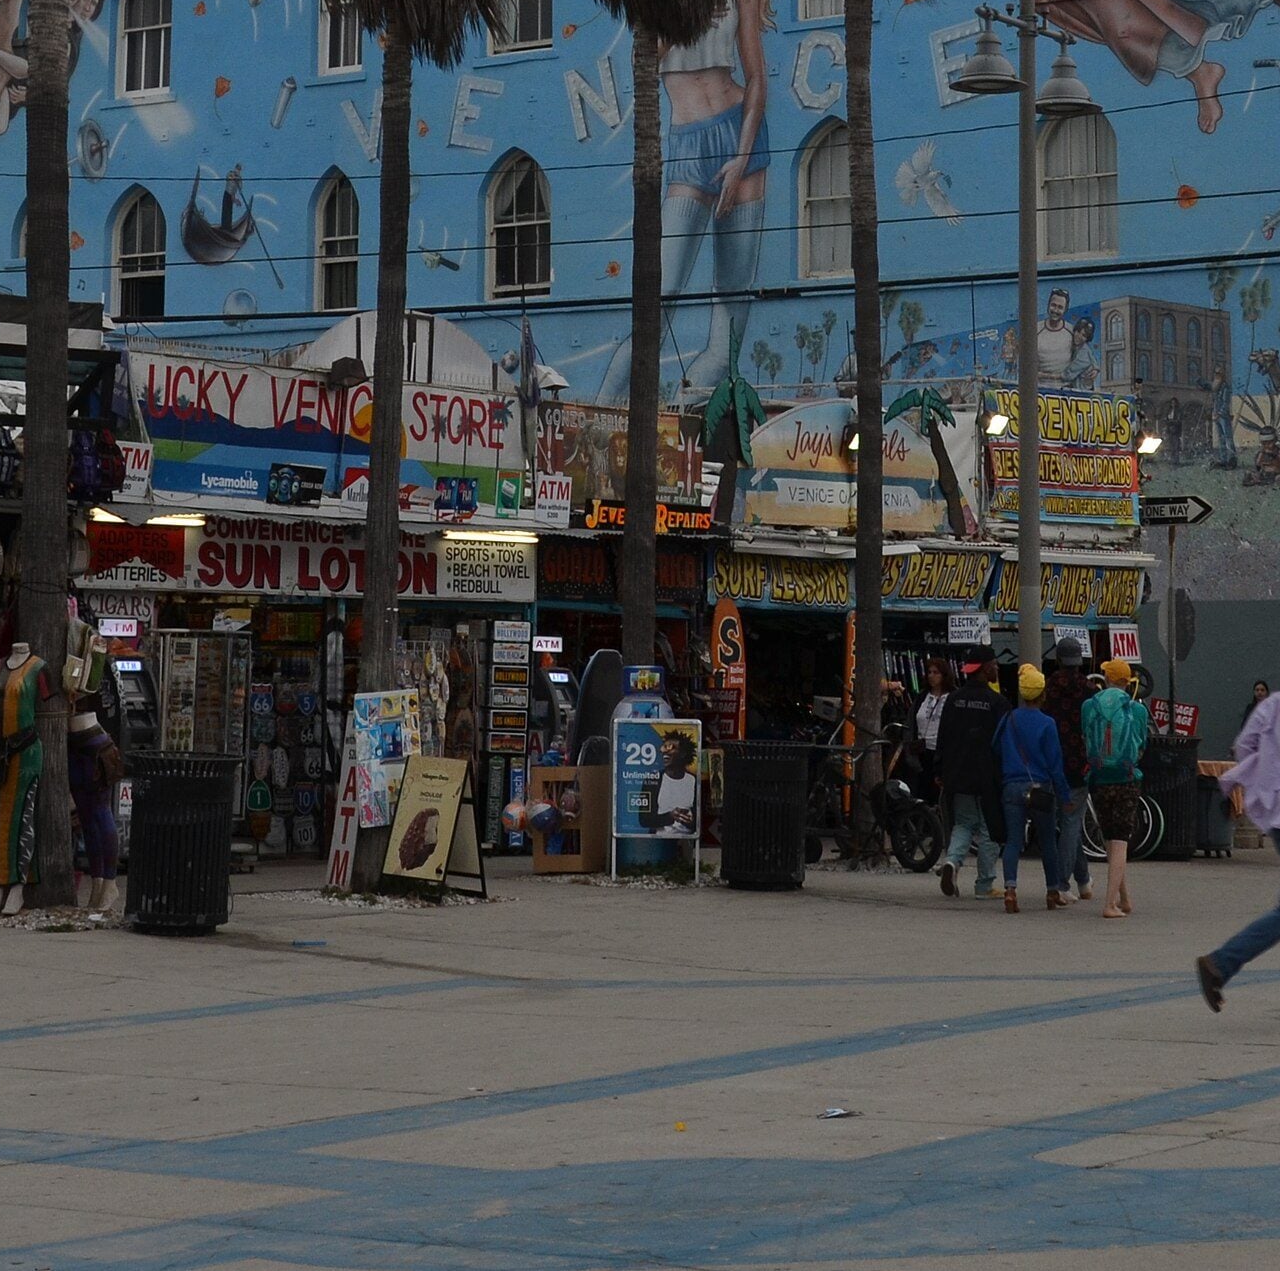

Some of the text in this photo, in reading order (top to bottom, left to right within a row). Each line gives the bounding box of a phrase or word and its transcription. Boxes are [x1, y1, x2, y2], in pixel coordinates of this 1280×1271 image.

[147, 365, 504, 450] UCKY VENIC STORE
[1037, 394, 1131, 445] RENTALS
[787, 421, 833, 468] Jay's
[122, 447, 150, 471] TM
[1071, 455, 1095, 485] SURF
[1096, 456, 1132, 486] BOARDS
[201, 472, 259, 490] Lycamobile
[538, 480, 570, 500] ATM
[788, 486, 835, 504] VENICE
[655, 503, 711, 533] REPAIRS
[1145, 504, 1190, 517] ONE WAY
[202, 516, 344, 544] CONVENIENCE
[98, 531, 168, 547] ADAPTERS
[446, 548, 524, 563] SPORTS TOYS
[96, 566, 167, 582] BATTERIES
[198, 541, 438, 595] SUN LOTON
[453, 563, 530, 579] BEACH TOWEL
[899, 551, 990, 599] RENTALS
[453, 579, 502, 594] REDBULL
[714, 550, 768, 597] SURF
[771, 555, 850, 606] LESSONS
[1055, 564, 1095, 616] BIKES
[1097, 567, 1140, 617] SKATES
[88, 593, 152, 617] CIGARS
[950, 617, 979, 627] ELECTRIC
[950, 630, 973, 639] SCOOTER
[1056, 628, 1087, 640] LUGGAGE
[536, 639, 560, 649] ATM
[1113, 633, 1138, 657] ATM
[253, 700, 270, 712] 66
[303, 696, 311, 710] 5
[1153, 710, 1193, 727] STOAGE
[300, 727, 314, 744] 66
[308, 762, 321, 776] 66
[622, 770, 660, 780] Unlimited
[255, 794, 262, 806] 1
[297, 793, 311, 804] 10
[630, 798, 649, 806] 5GB
[329, 766, 357, 886] ATM
[298, 828, 314, 843] 101
